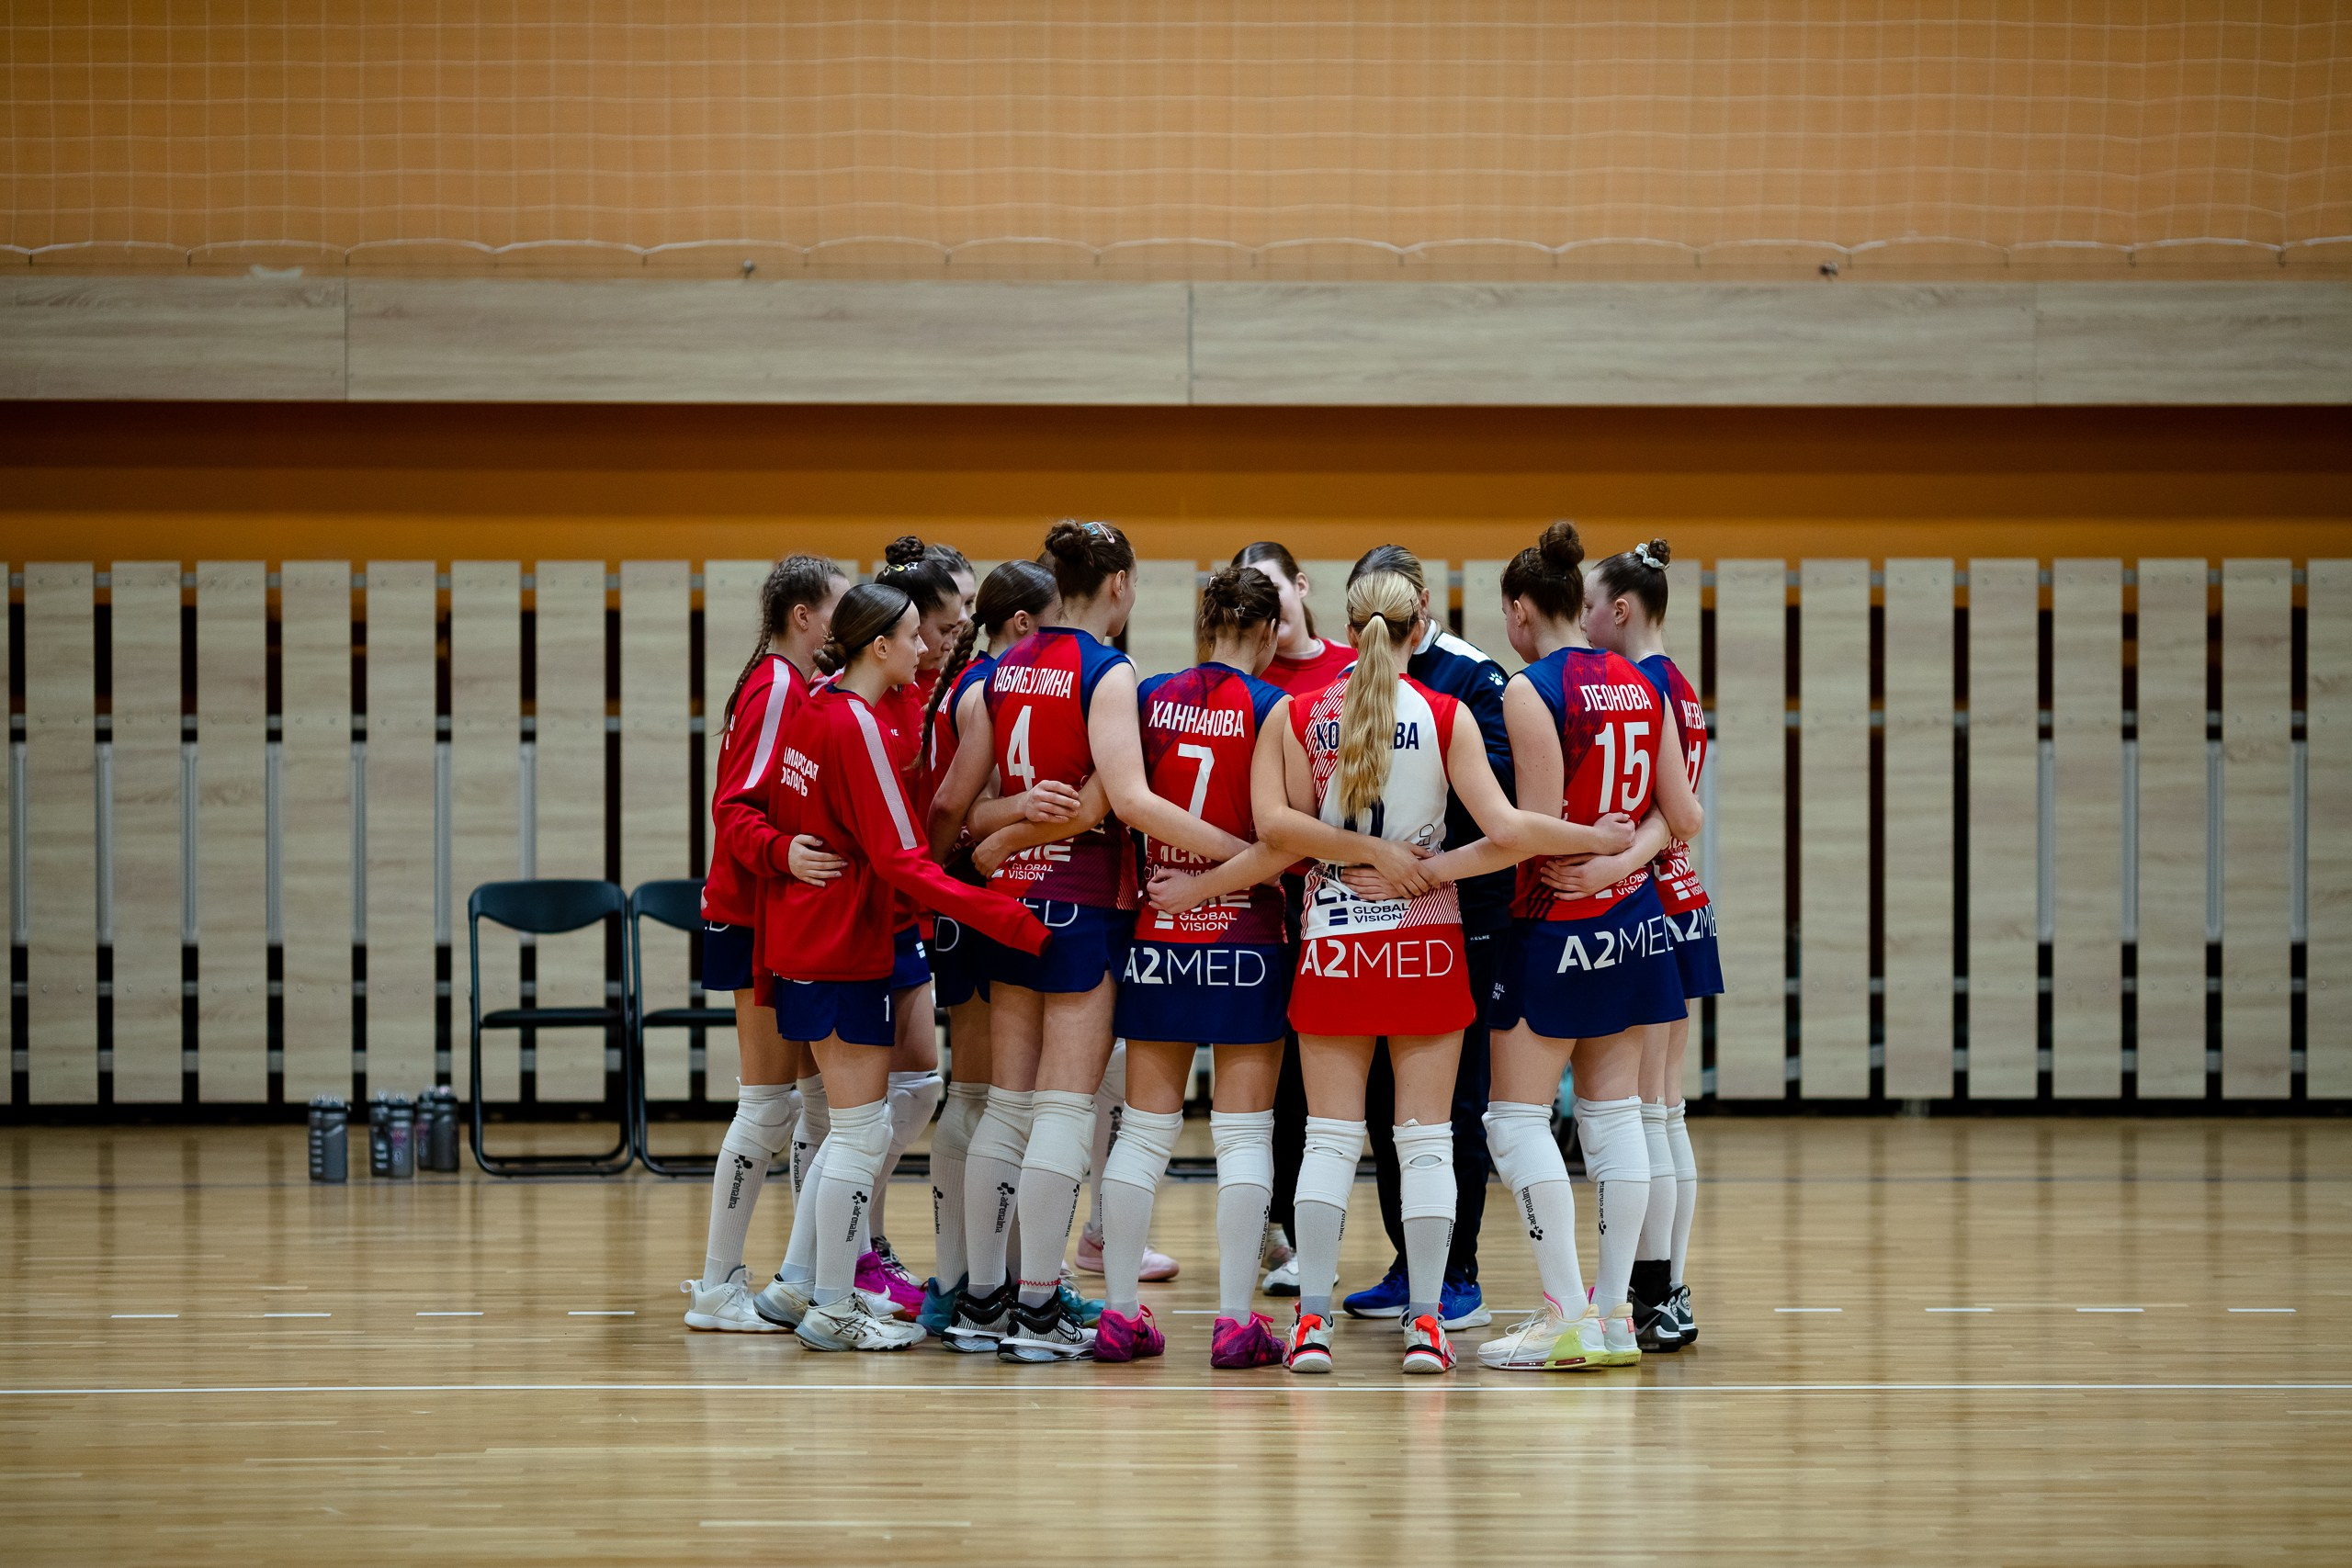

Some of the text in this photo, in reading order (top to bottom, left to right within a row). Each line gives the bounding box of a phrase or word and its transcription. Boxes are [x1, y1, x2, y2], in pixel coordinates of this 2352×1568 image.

[1579, 684, 1652, 712] ЛЕОНОВА
[1007, 705, 1035, 791] 4
[1177, 742, 1215, 820] 7
[1595, 721, 1650, 814] 15
[1008, 870, 1045, 882] VISION
[1179, 911, 1238, 921] GLOBAL
[1352, 903, 1410, 915] GLOBAL
[1354, 912, 1403, 924] VISION
[1180, 921, 1229, 931] VISION
[1123, 947, 1266, 987] A2MED
[1301, 939, 1453, 978] A2MED
